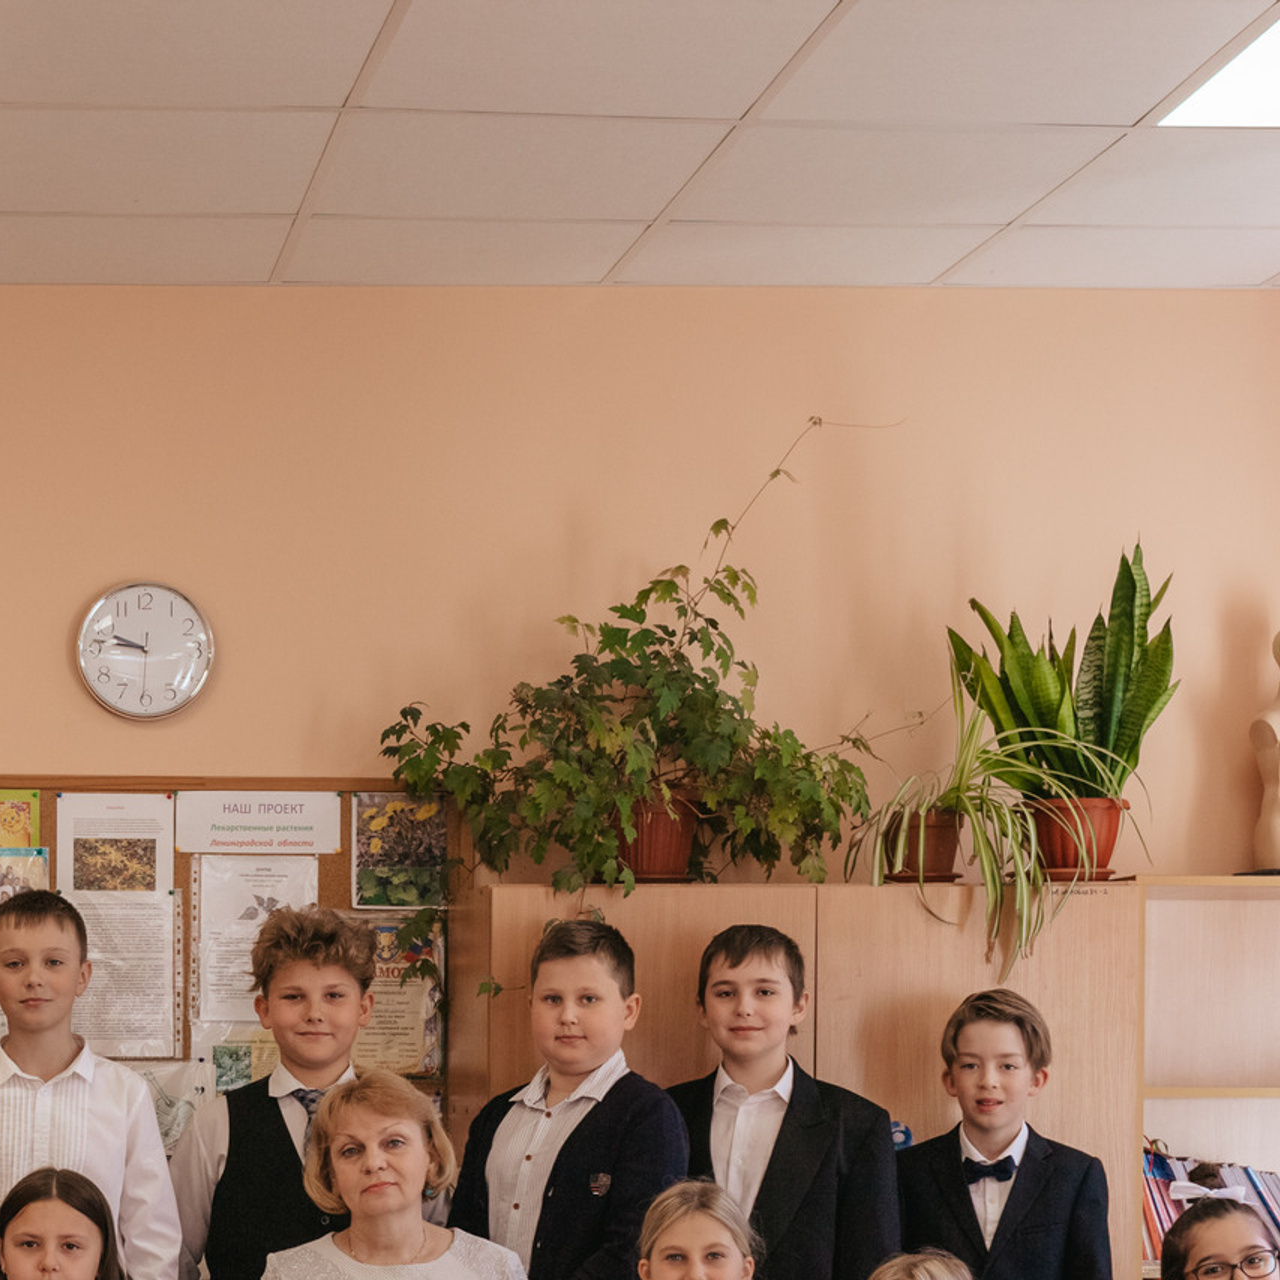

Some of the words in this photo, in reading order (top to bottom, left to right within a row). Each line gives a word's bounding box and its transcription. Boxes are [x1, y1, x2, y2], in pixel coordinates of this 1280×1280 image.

[116, 600, 127, 618] 11
[137, 592, 154, 610] 12
[169, 600, 174, 618] 1
[182, 617, 195, 636] 2
[190, 639, 203, 659] 3
[96, 666, 111, 685] 8
[116, 683, 128, 700] 7
[139, 688, 153, 708] 6
[163, 682, 178, 702] 5
[222, 803, 251, 815] НАШ
[258, 803, 306, 815] ПРОЕКТ
[210, 823, 274, 833] Лекарственные
[275, 824, 313, 833] растения
[209, 838, 274, 847] Ленинградской
[277, 838, 314, 847] области
